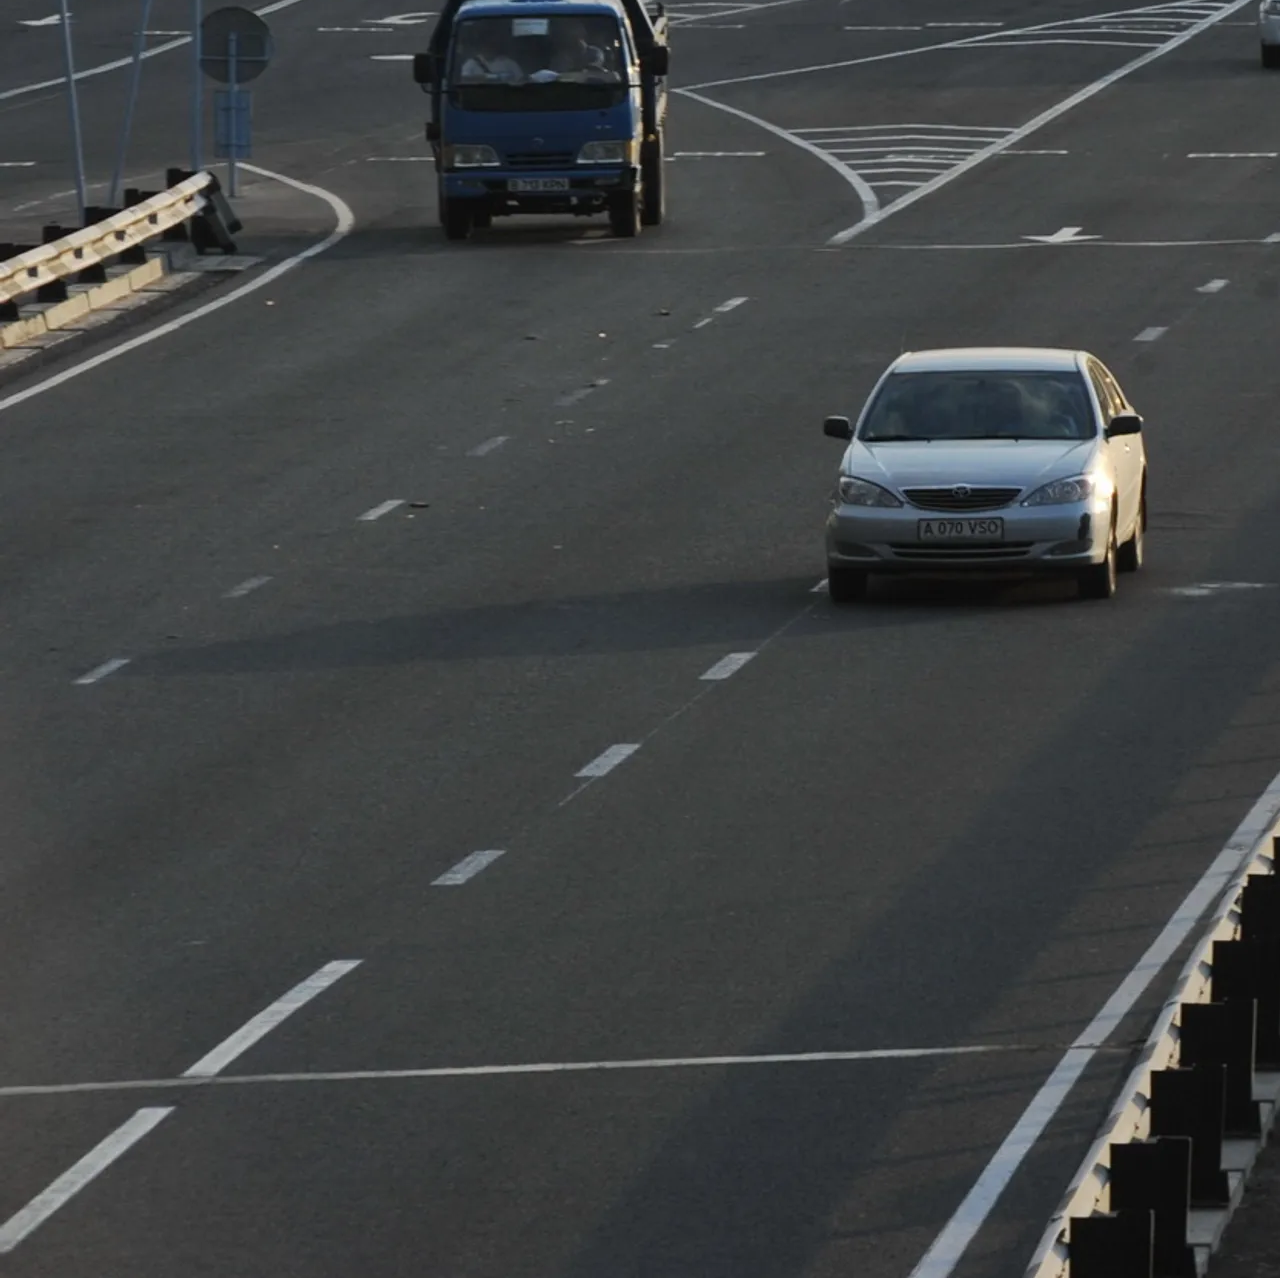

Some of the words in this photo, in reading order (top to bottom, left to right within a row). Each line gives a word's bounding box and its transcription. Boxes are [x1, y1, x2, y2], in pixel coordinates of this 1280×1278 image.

[924, 523, 934, 535] A
[938, 522, 963, 535] 070
[967, 520, 998, 535] VSO
